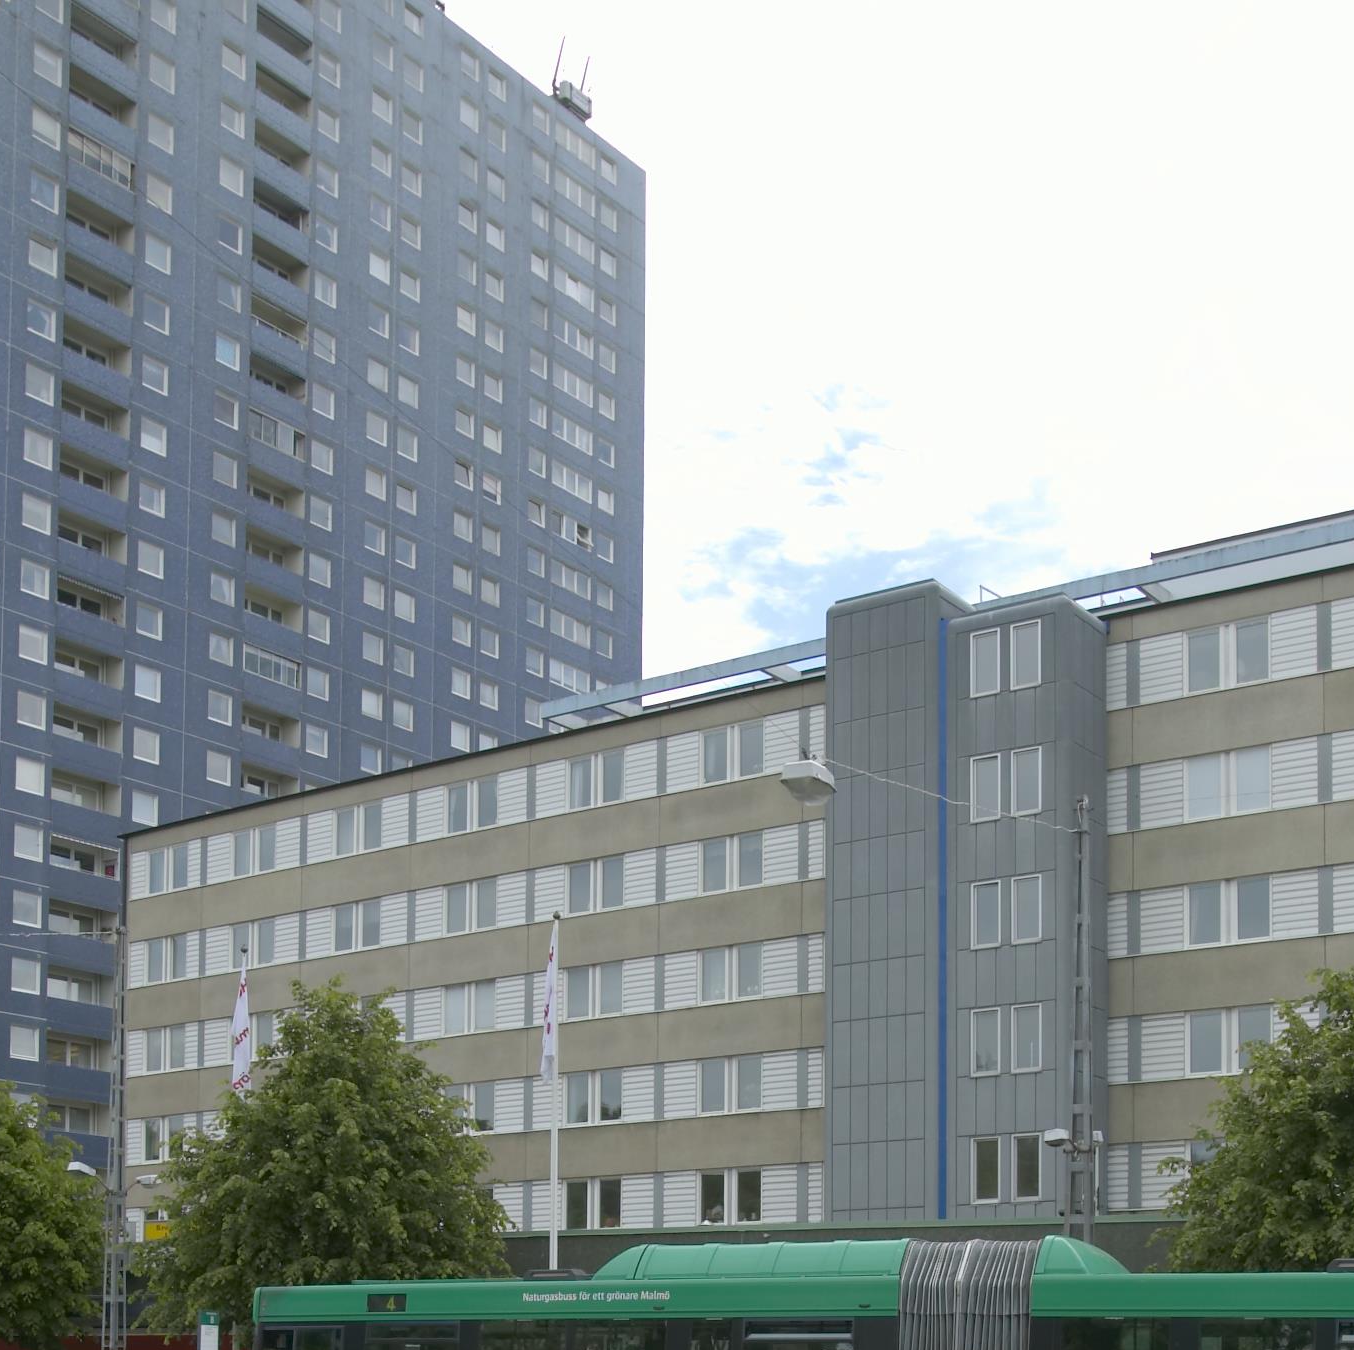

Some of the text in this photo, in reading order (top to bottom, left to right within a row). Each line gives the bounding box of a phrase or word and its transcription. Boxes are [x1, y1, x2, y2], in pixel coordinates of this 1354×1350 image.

[386, 1295, 397, 1312] 4
[522, 1290, 670, 1303] Naturgasbuss för ett grönare Malmö
